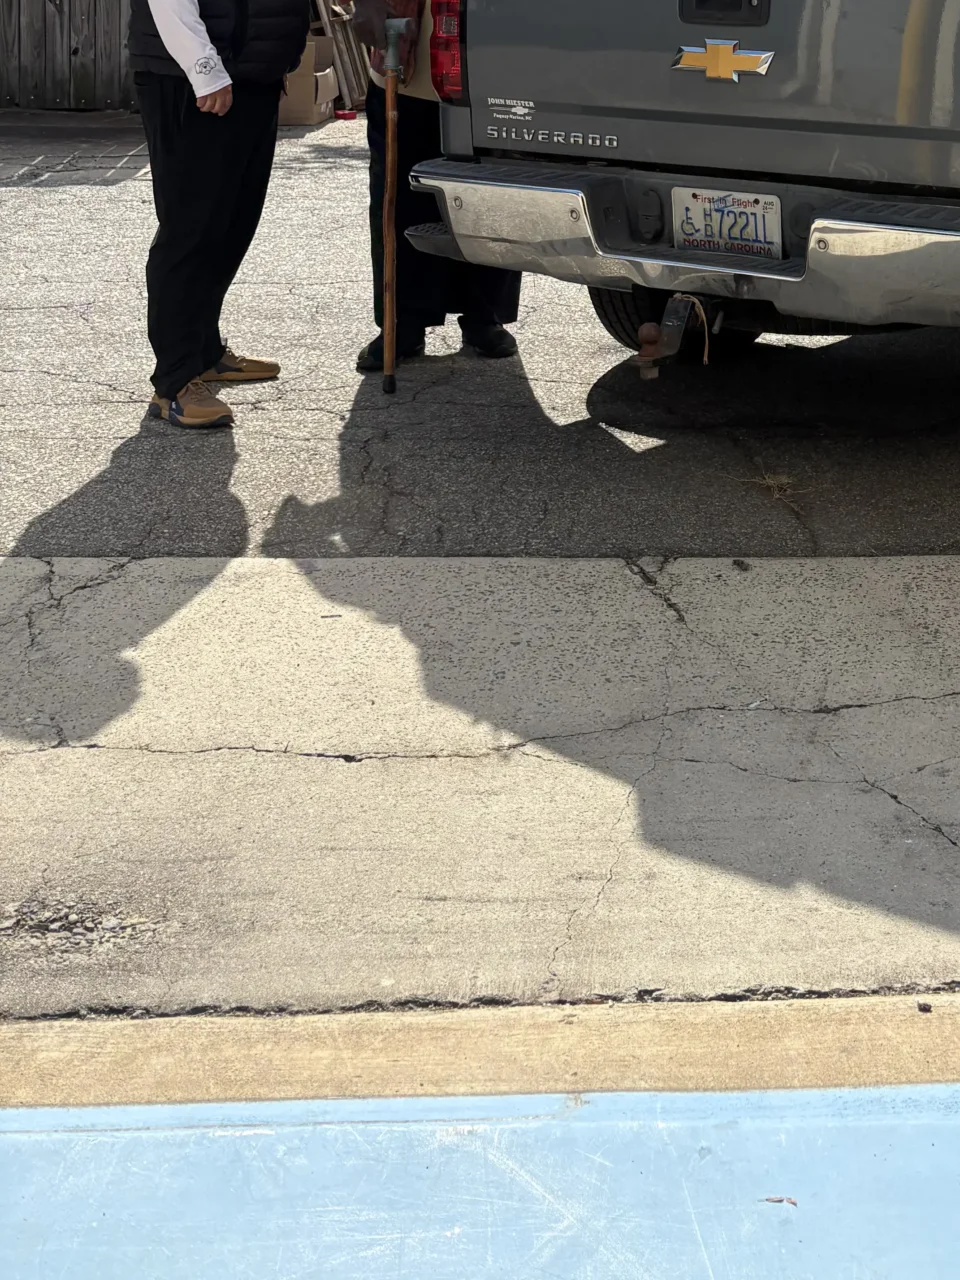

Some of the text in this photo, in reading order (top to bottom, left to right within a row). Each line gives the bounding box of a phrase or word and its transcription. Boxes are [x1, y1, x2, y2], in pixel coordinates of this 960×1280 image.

[487, 126, 618, 148] SILVERADO
[696, 194, 714, 204] First
[732, 198, 756, 208] Flight
[684, 238, 773, 256] NORTH CAROLINA
